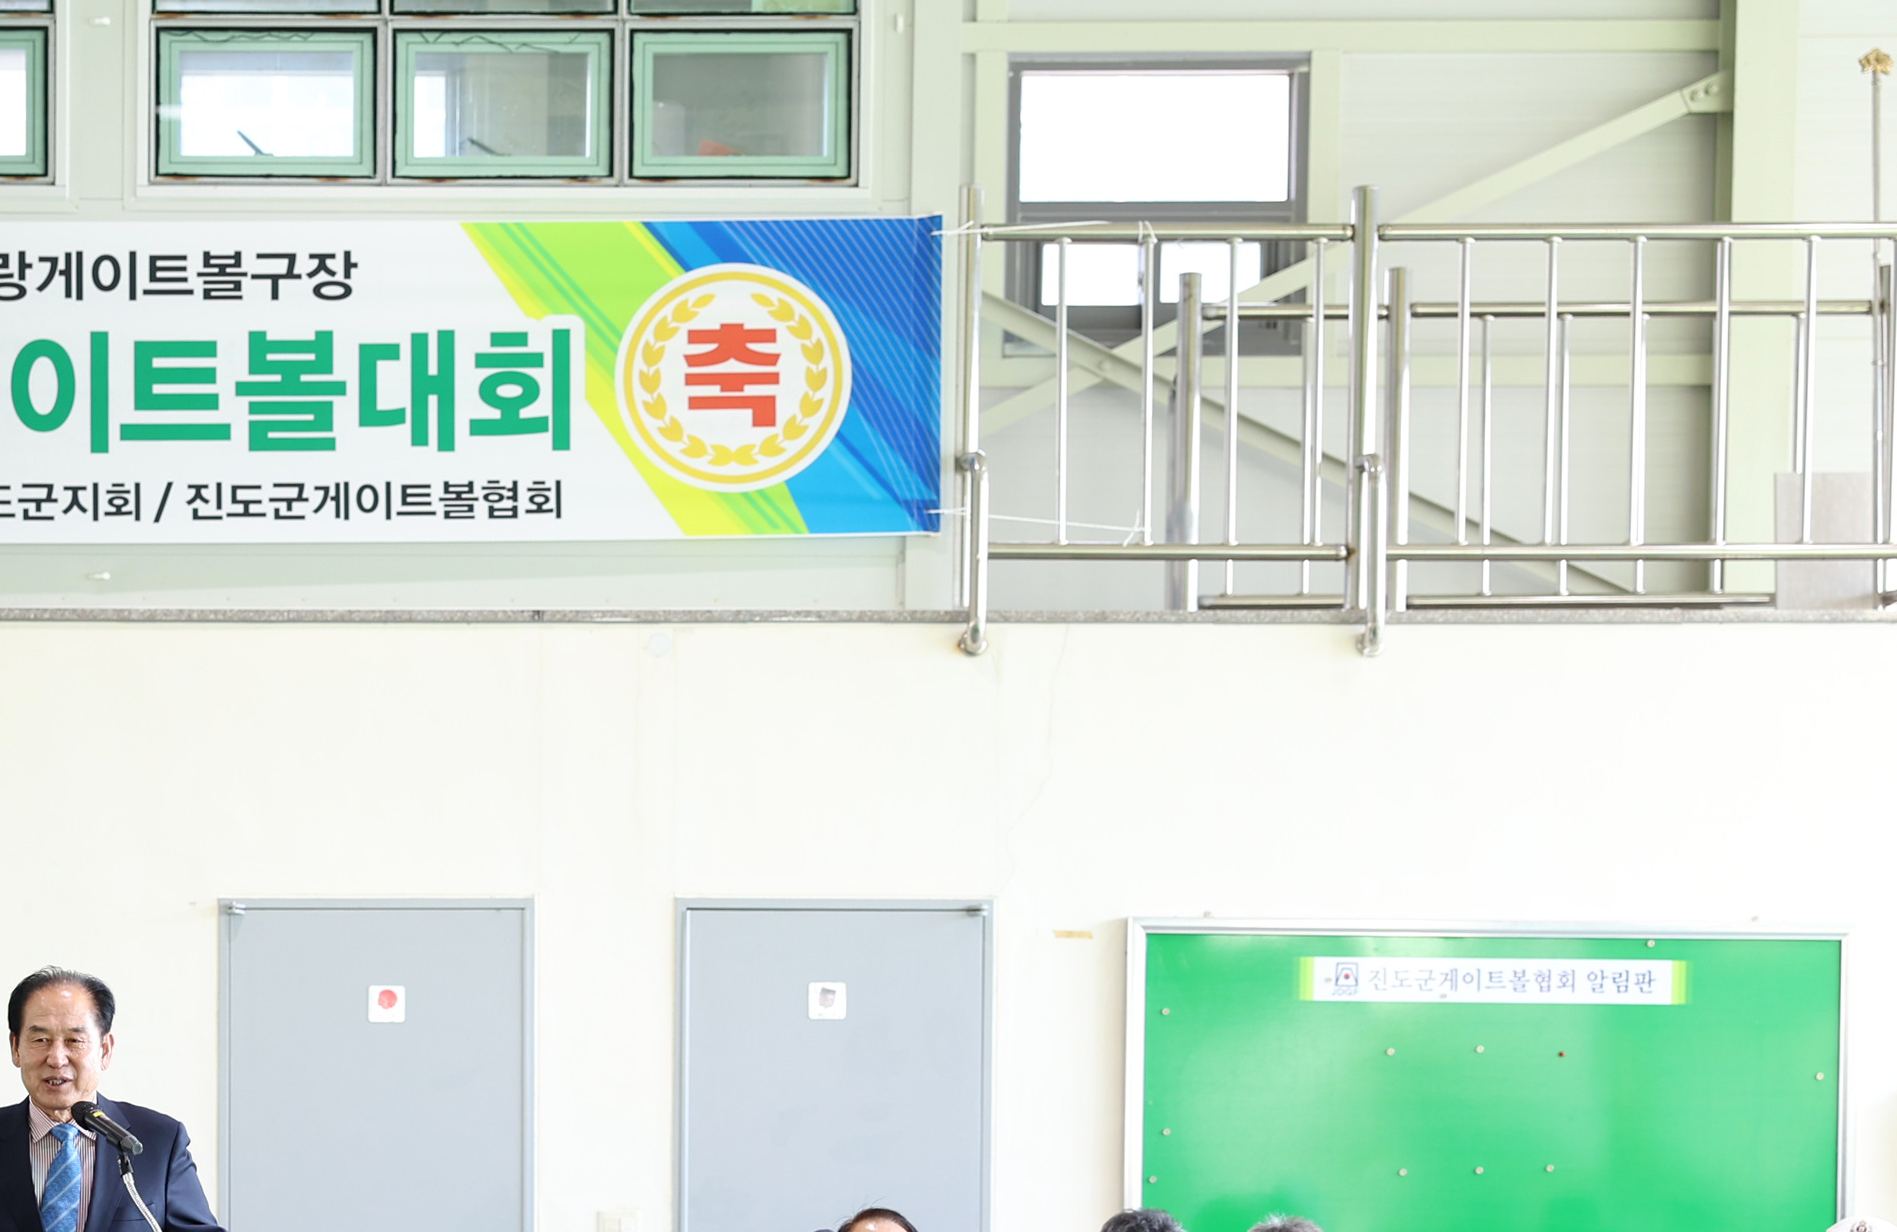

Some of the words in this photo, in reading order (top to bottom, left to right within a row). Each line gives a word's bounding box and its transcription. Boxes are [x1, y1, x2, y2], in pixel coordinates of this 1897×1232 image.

[683, 323, 781, 427] 축
[186, 481, 563, 521] 진도군게이트볼협회
[1368, 967, 1576, 993] 진도군게이트볼협회
[1586, 969, 1656, 995] 알림판
